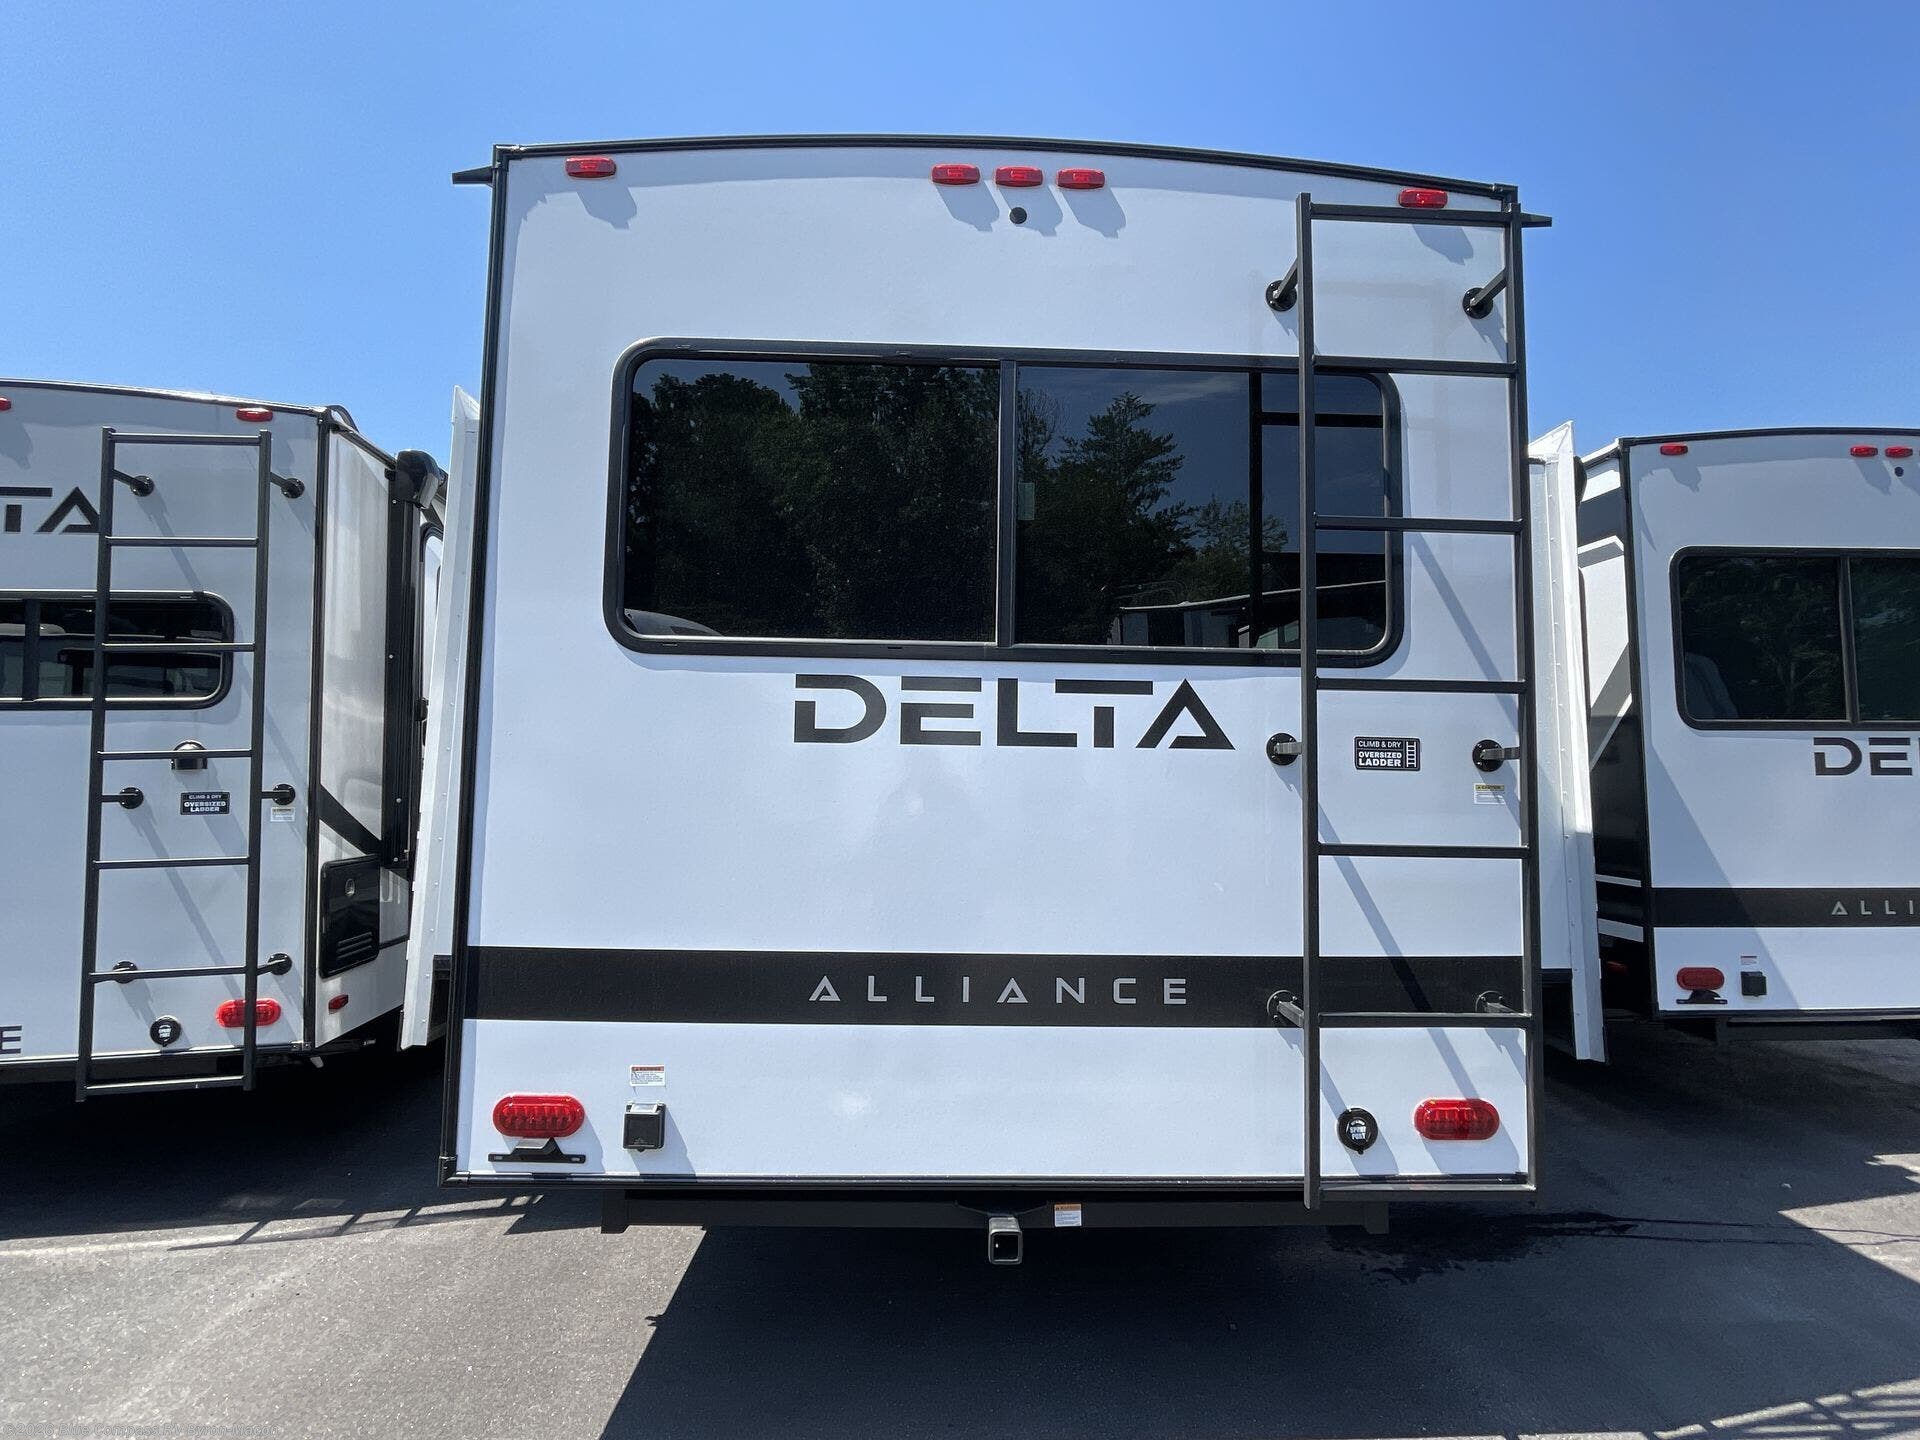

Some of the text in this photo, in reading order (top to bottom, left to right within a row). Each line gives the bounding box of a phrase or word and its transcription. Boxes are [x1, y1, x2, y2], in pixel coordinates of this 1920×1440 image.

[794, 673, 1235, 750] DELTA
[1358, 740, 1380, 748] CLIMB
[1358, 751, 1403, 759] OVERSIZED
[1358, 758, 1402, 767] LADDER
[1813, 737, 1920, 776] DE
[1831, 900, 1915, 915] ALLI
[808, 975, 1187, 1005] ALLIANCE
